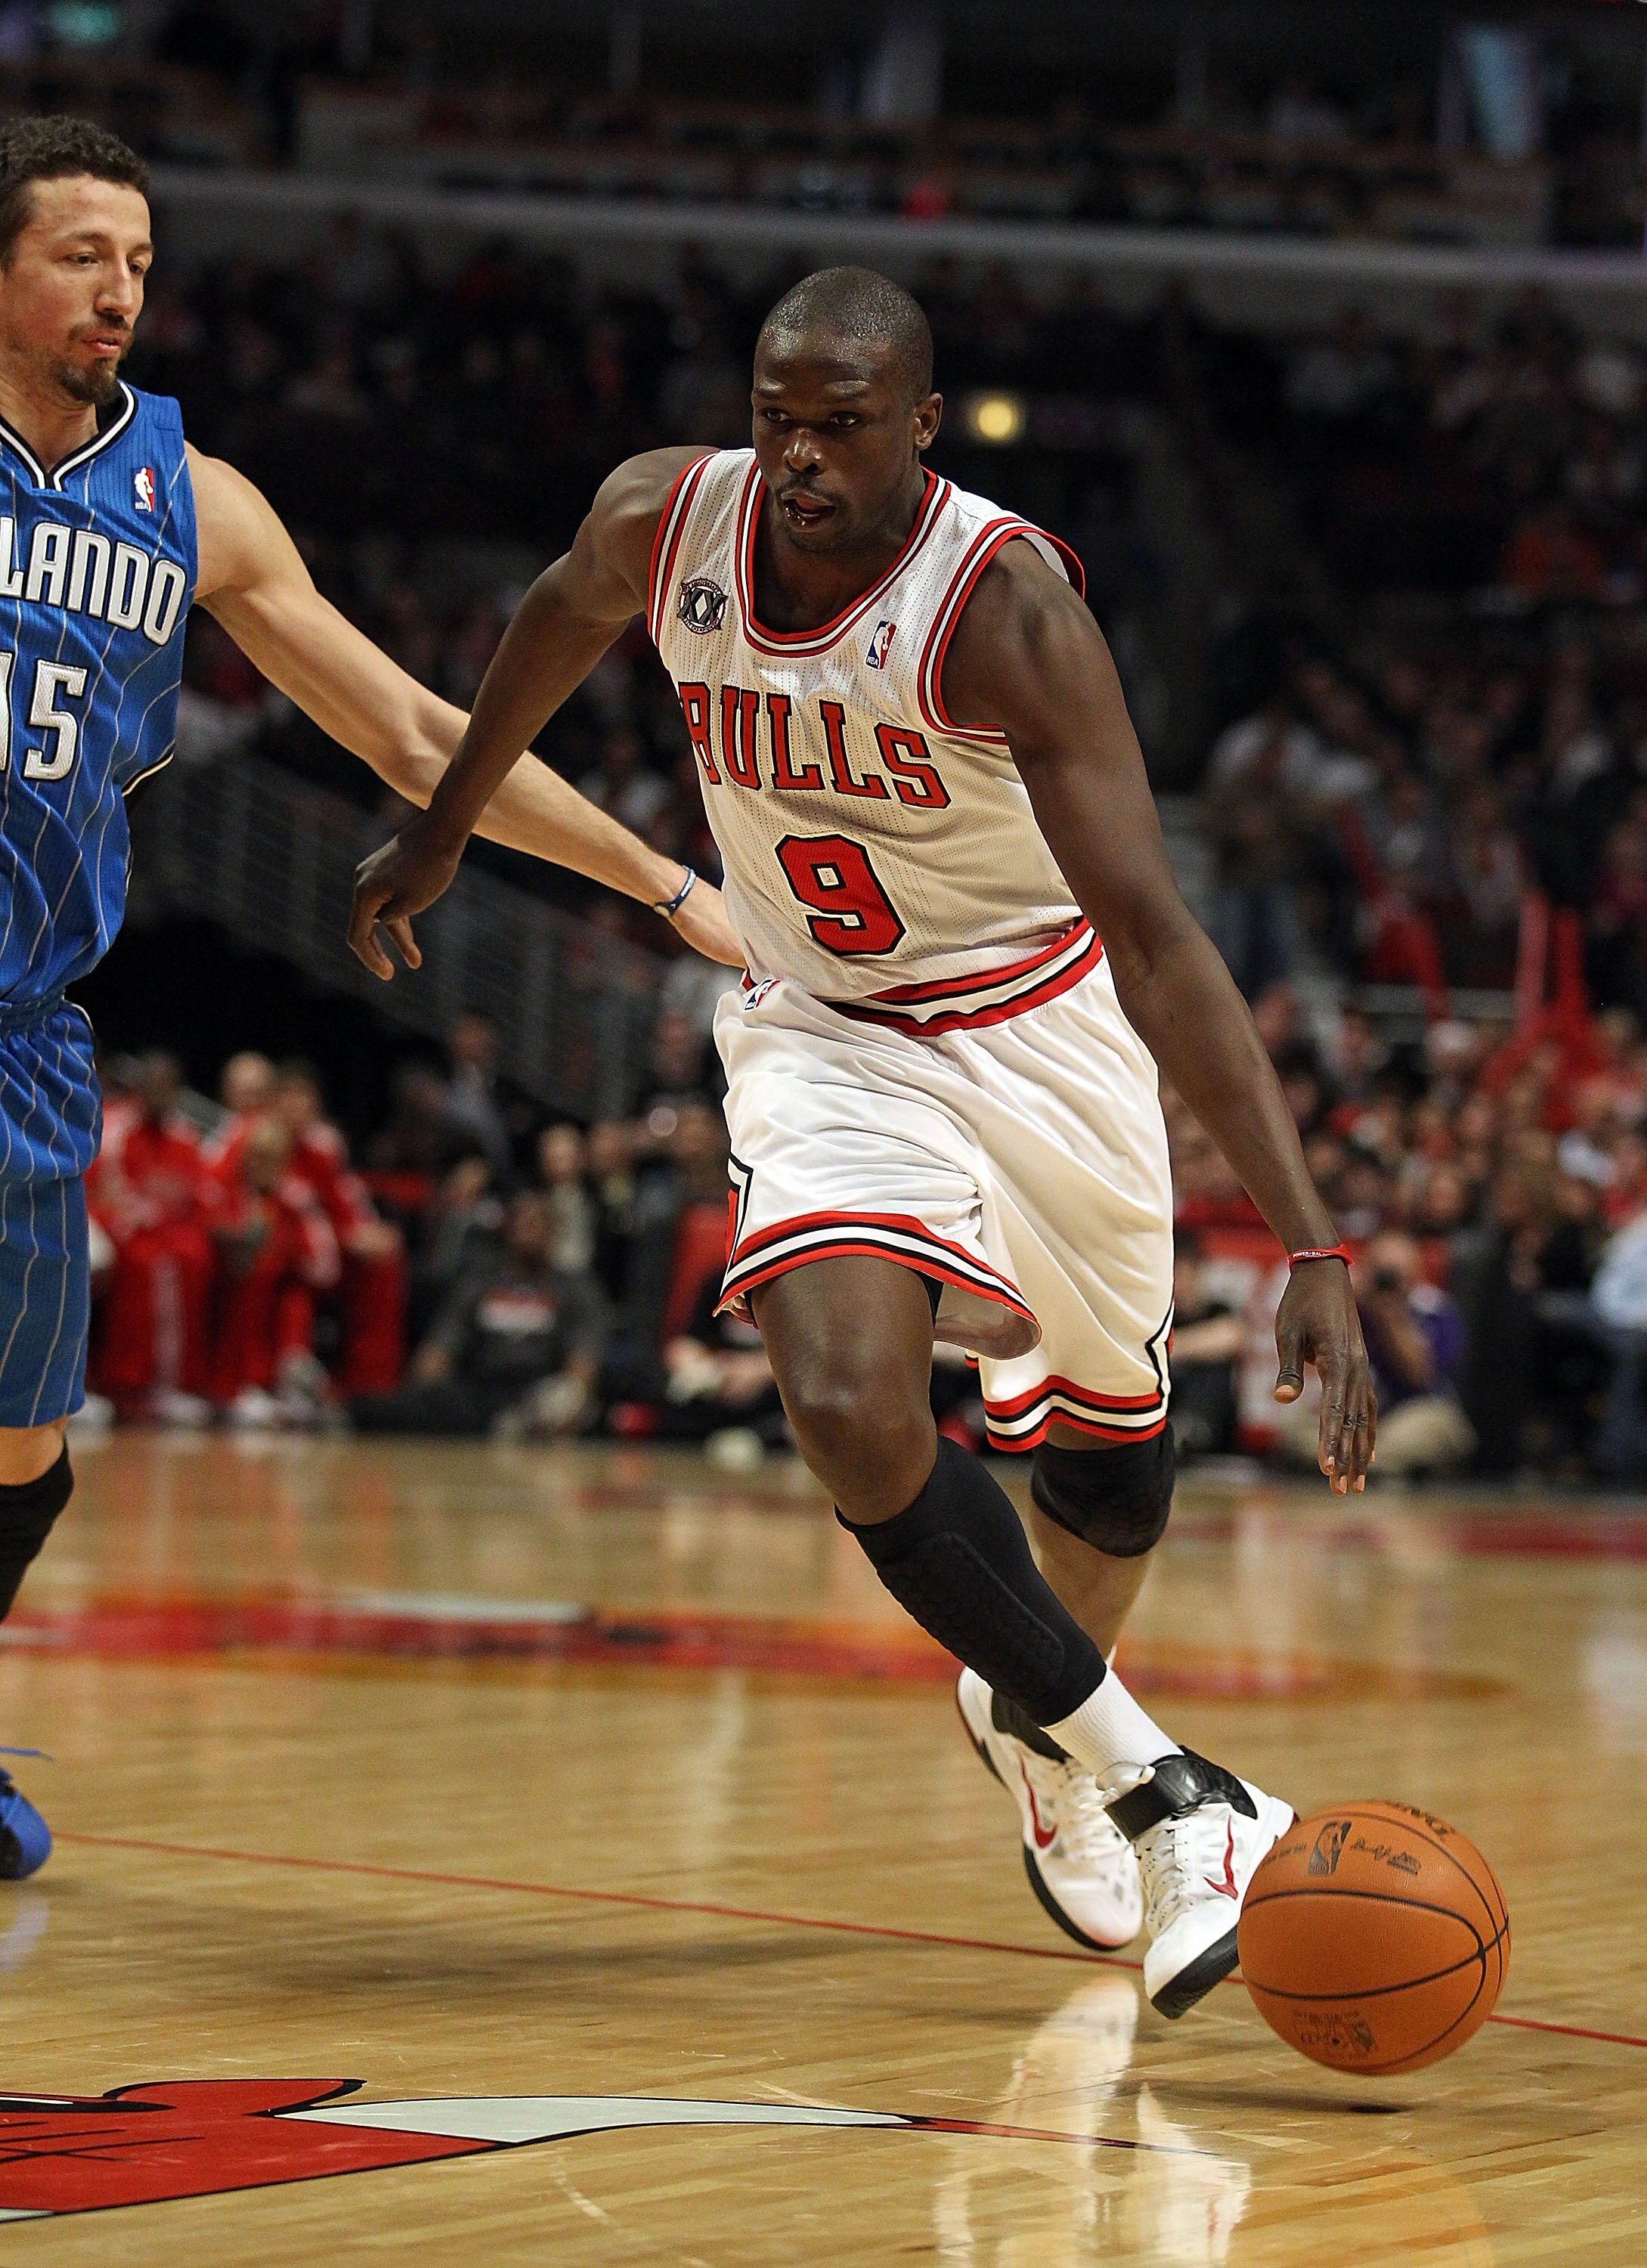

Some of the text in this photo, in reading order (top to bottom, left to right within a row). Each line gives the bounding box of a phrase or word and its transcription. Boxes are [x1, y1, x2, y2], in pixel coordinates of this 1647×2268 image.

[866, 655, 878, 666] NBA
[678, 681, 952, 809] BULLS
[774, 834, 906, 956] 9
